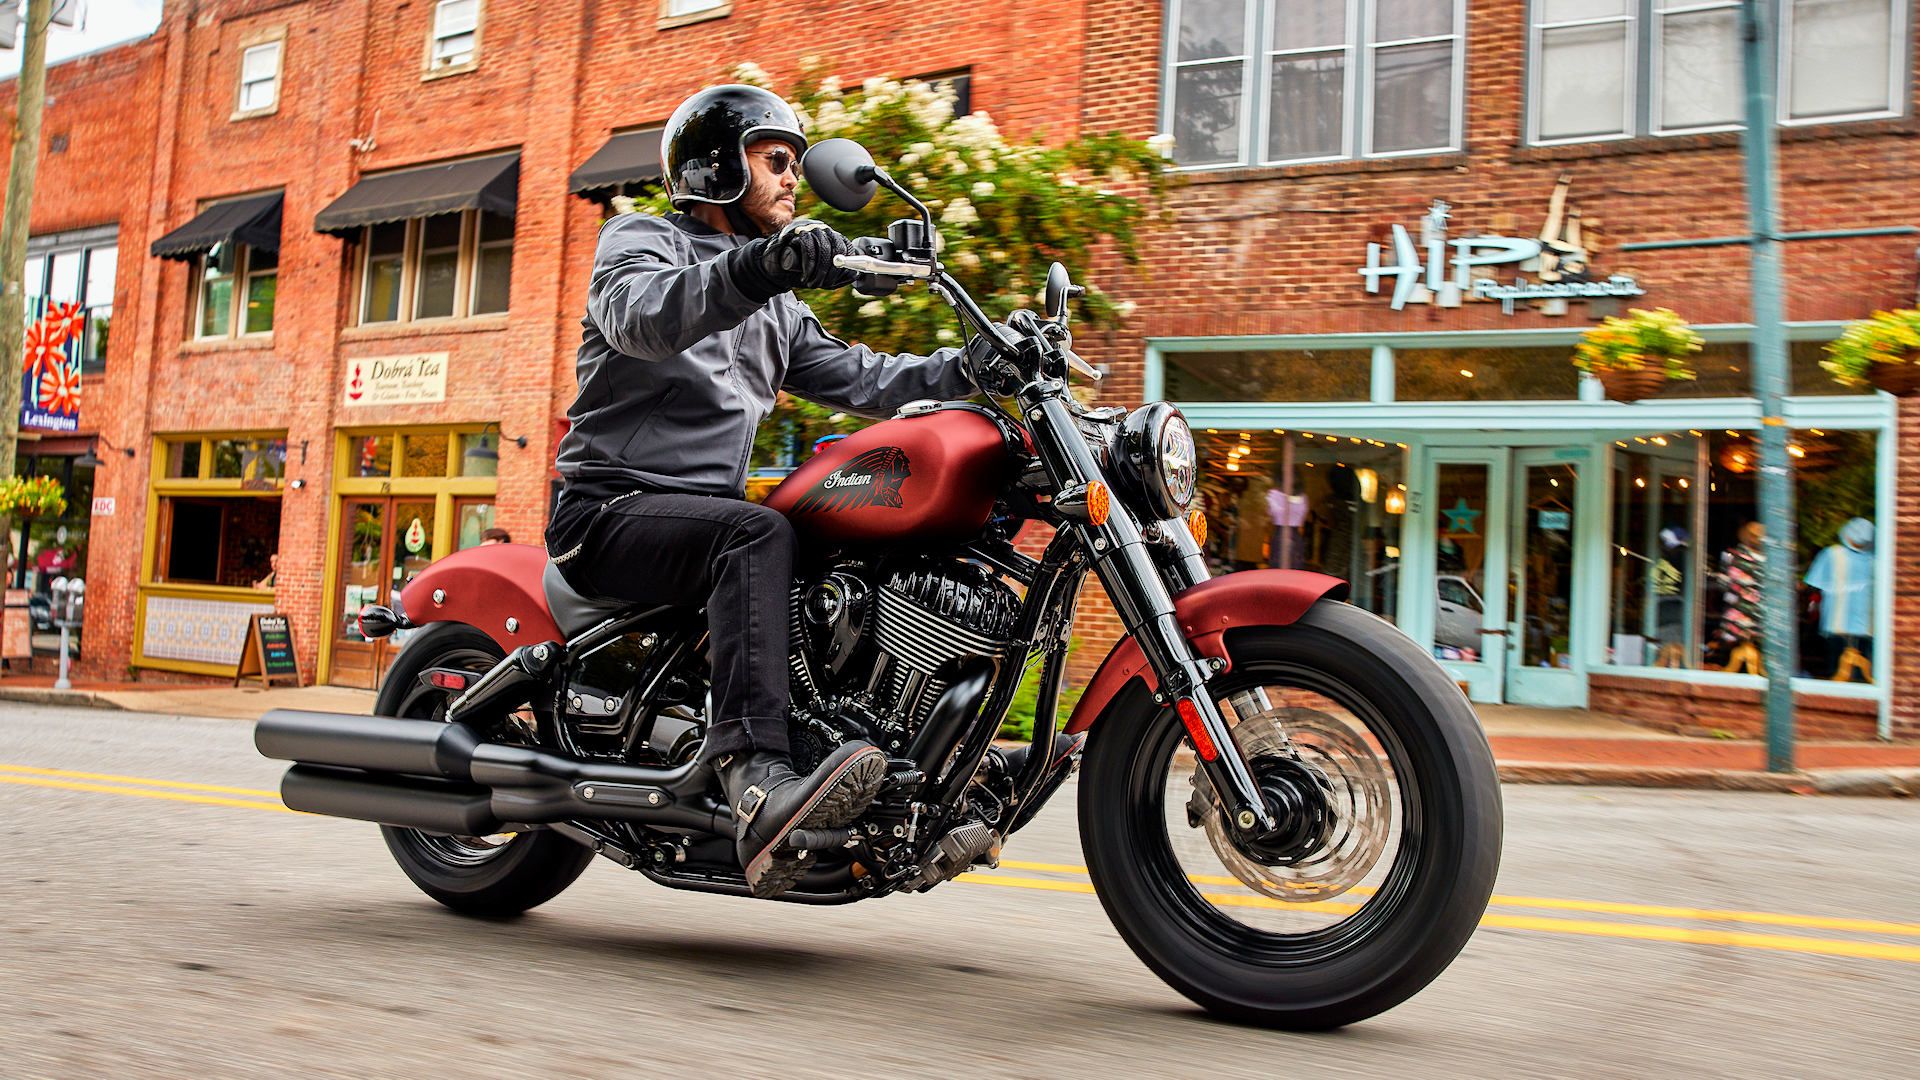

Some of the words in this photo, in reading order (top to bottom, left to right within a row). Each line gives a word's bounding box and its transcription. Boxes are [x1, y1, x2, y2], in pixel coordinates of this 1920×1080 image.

[371, 358, 413, 380] Dobrá
[416, 356, 441, 377] Tea
[24, 411, 77, 431] Lexington
[824, 470, 872, 489] Indian
